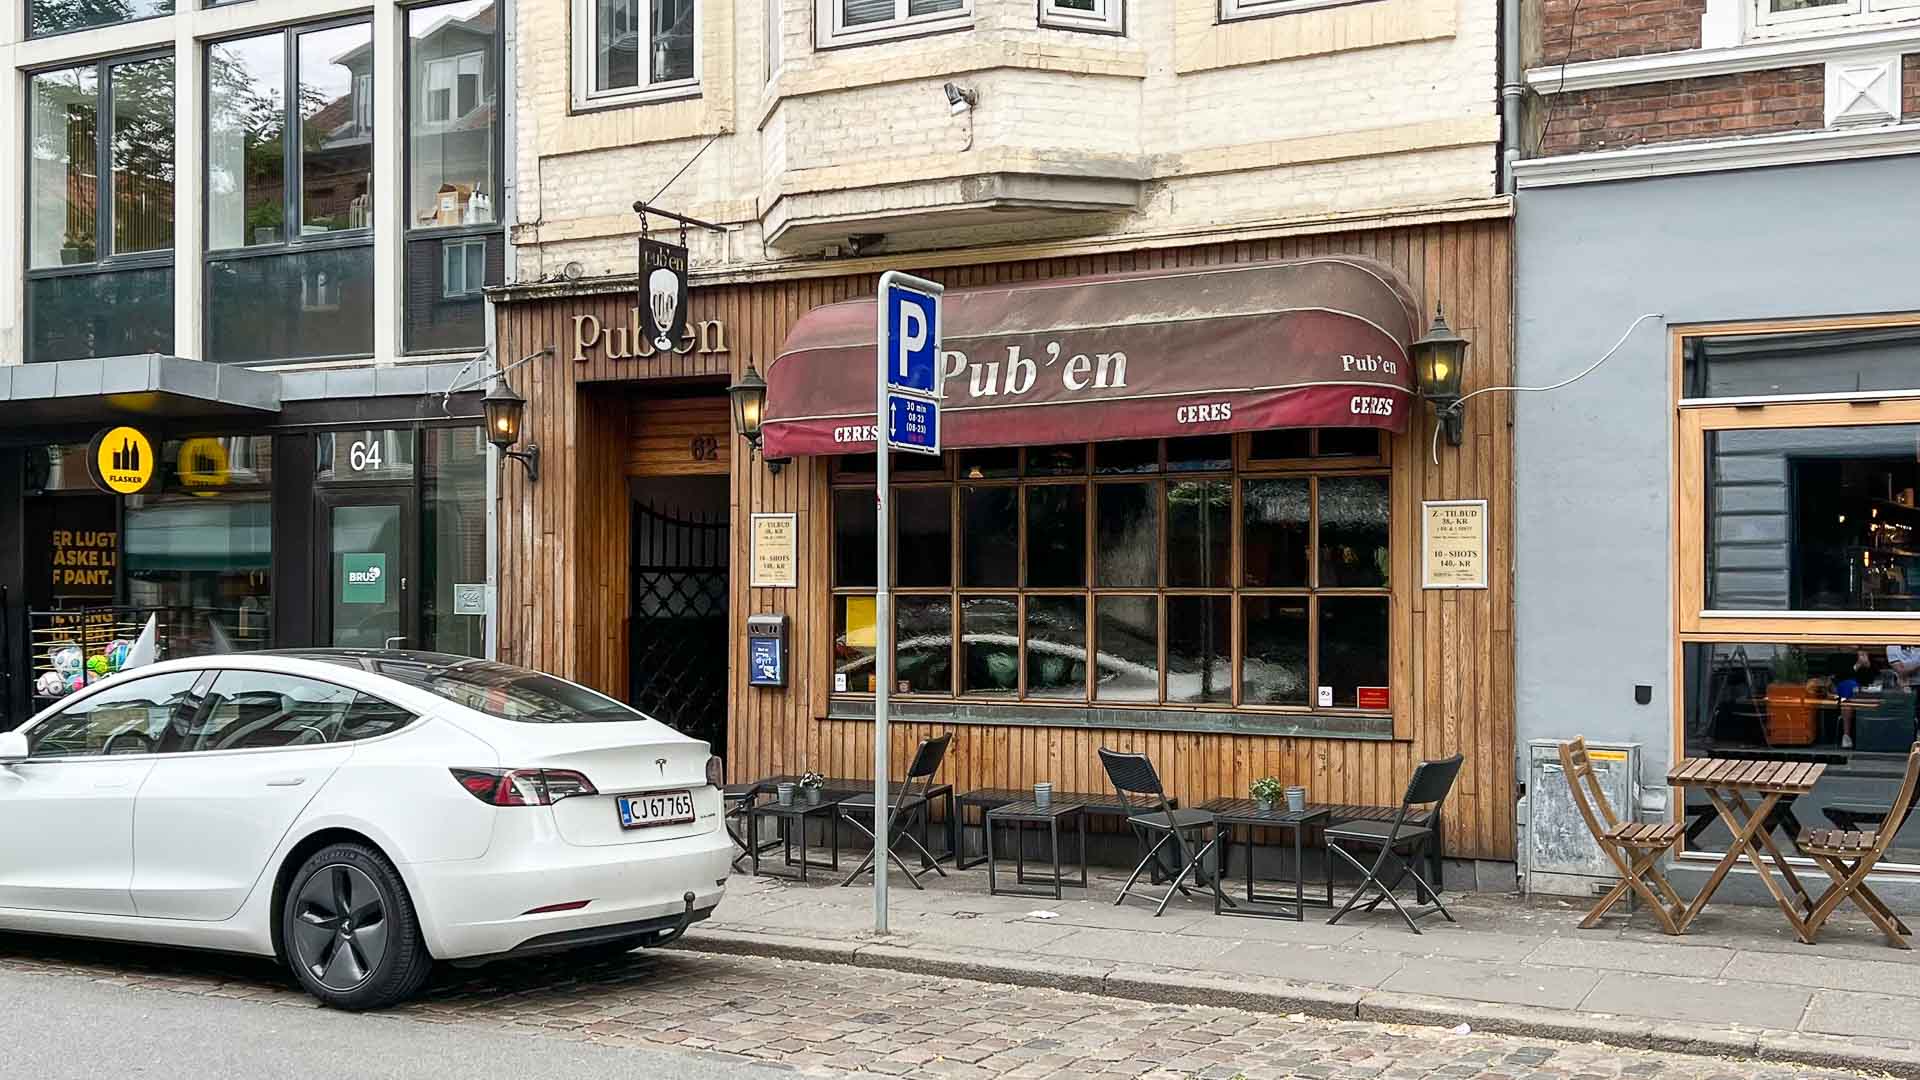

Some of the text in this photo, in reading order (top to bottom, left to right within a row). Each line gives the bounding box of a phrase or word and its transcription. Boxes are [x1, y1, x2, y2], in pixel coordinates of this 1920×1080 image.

[572, 307, 729, 361] Puben
[900, 300, 928, 377] P
[906, 401, 915, 412] 30
[1177, 403, 1232, 423] CERES
[1350, 397, 1393, 416] CERES
[834, 425, 879, 443] CERES
[350, 440, 382, 470] 64
[110, 475, 142, 484] FLASKER
[1449, 550, 1478, 558] SHOTS
[64, 569, 113, 585] PANT.
[349, 571, 376, 582] BRUS
